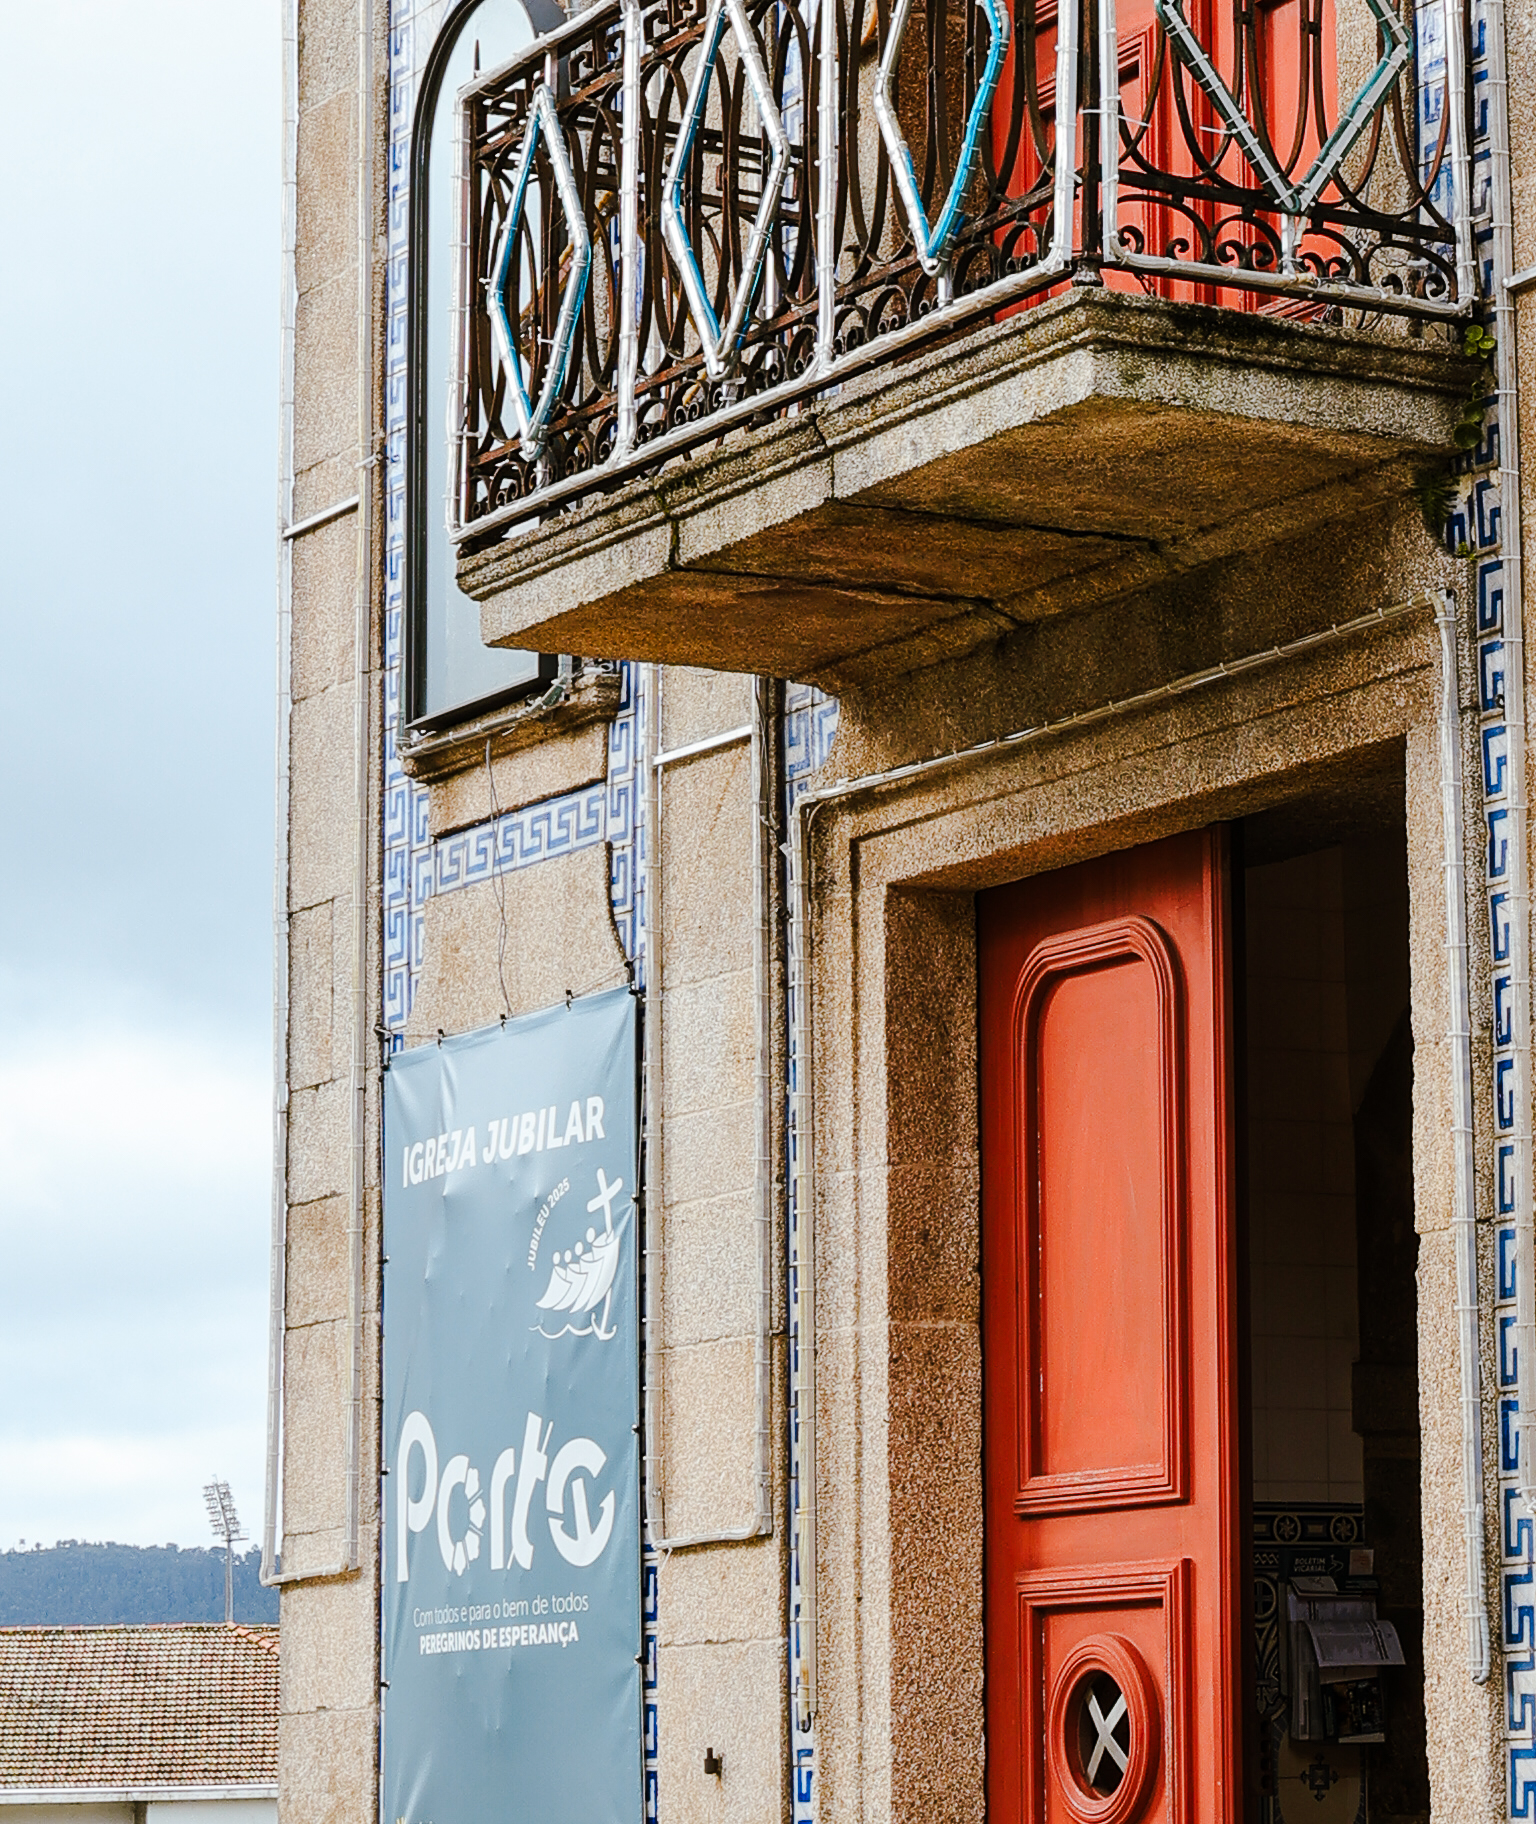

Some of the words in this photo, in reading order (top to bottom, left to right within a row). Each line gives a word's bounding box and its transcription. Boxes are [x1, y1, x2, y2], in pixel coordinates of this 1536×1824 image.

[403, 1126, 476, 1188] IGREJA
[482, 1096, 605, 1164] JUBILAR
[527, 1204, 550, 1271] JUBILEU
[547, 1177, 570, 1208] 2025
[397, 1410, 615, 1583] Porto
[414, 1607, 433, 1627] Com
[434, 1604, 459, 1625] todos
[461, 1608, 467, 1621] e
[469, 1605, 491, 1625] para
[493, 1603, 500, 1619] o
[502, 1598, 529, 1618] bem
[532, 1595, 549, 1615] de
[552, 1591, 589, 1613] todos
[420, 1629, 481, 1655] PEREGRINOS
[483, 1628, 497, 1650] DE
[499, 1621, 579, 1648] ESPERANÇA
